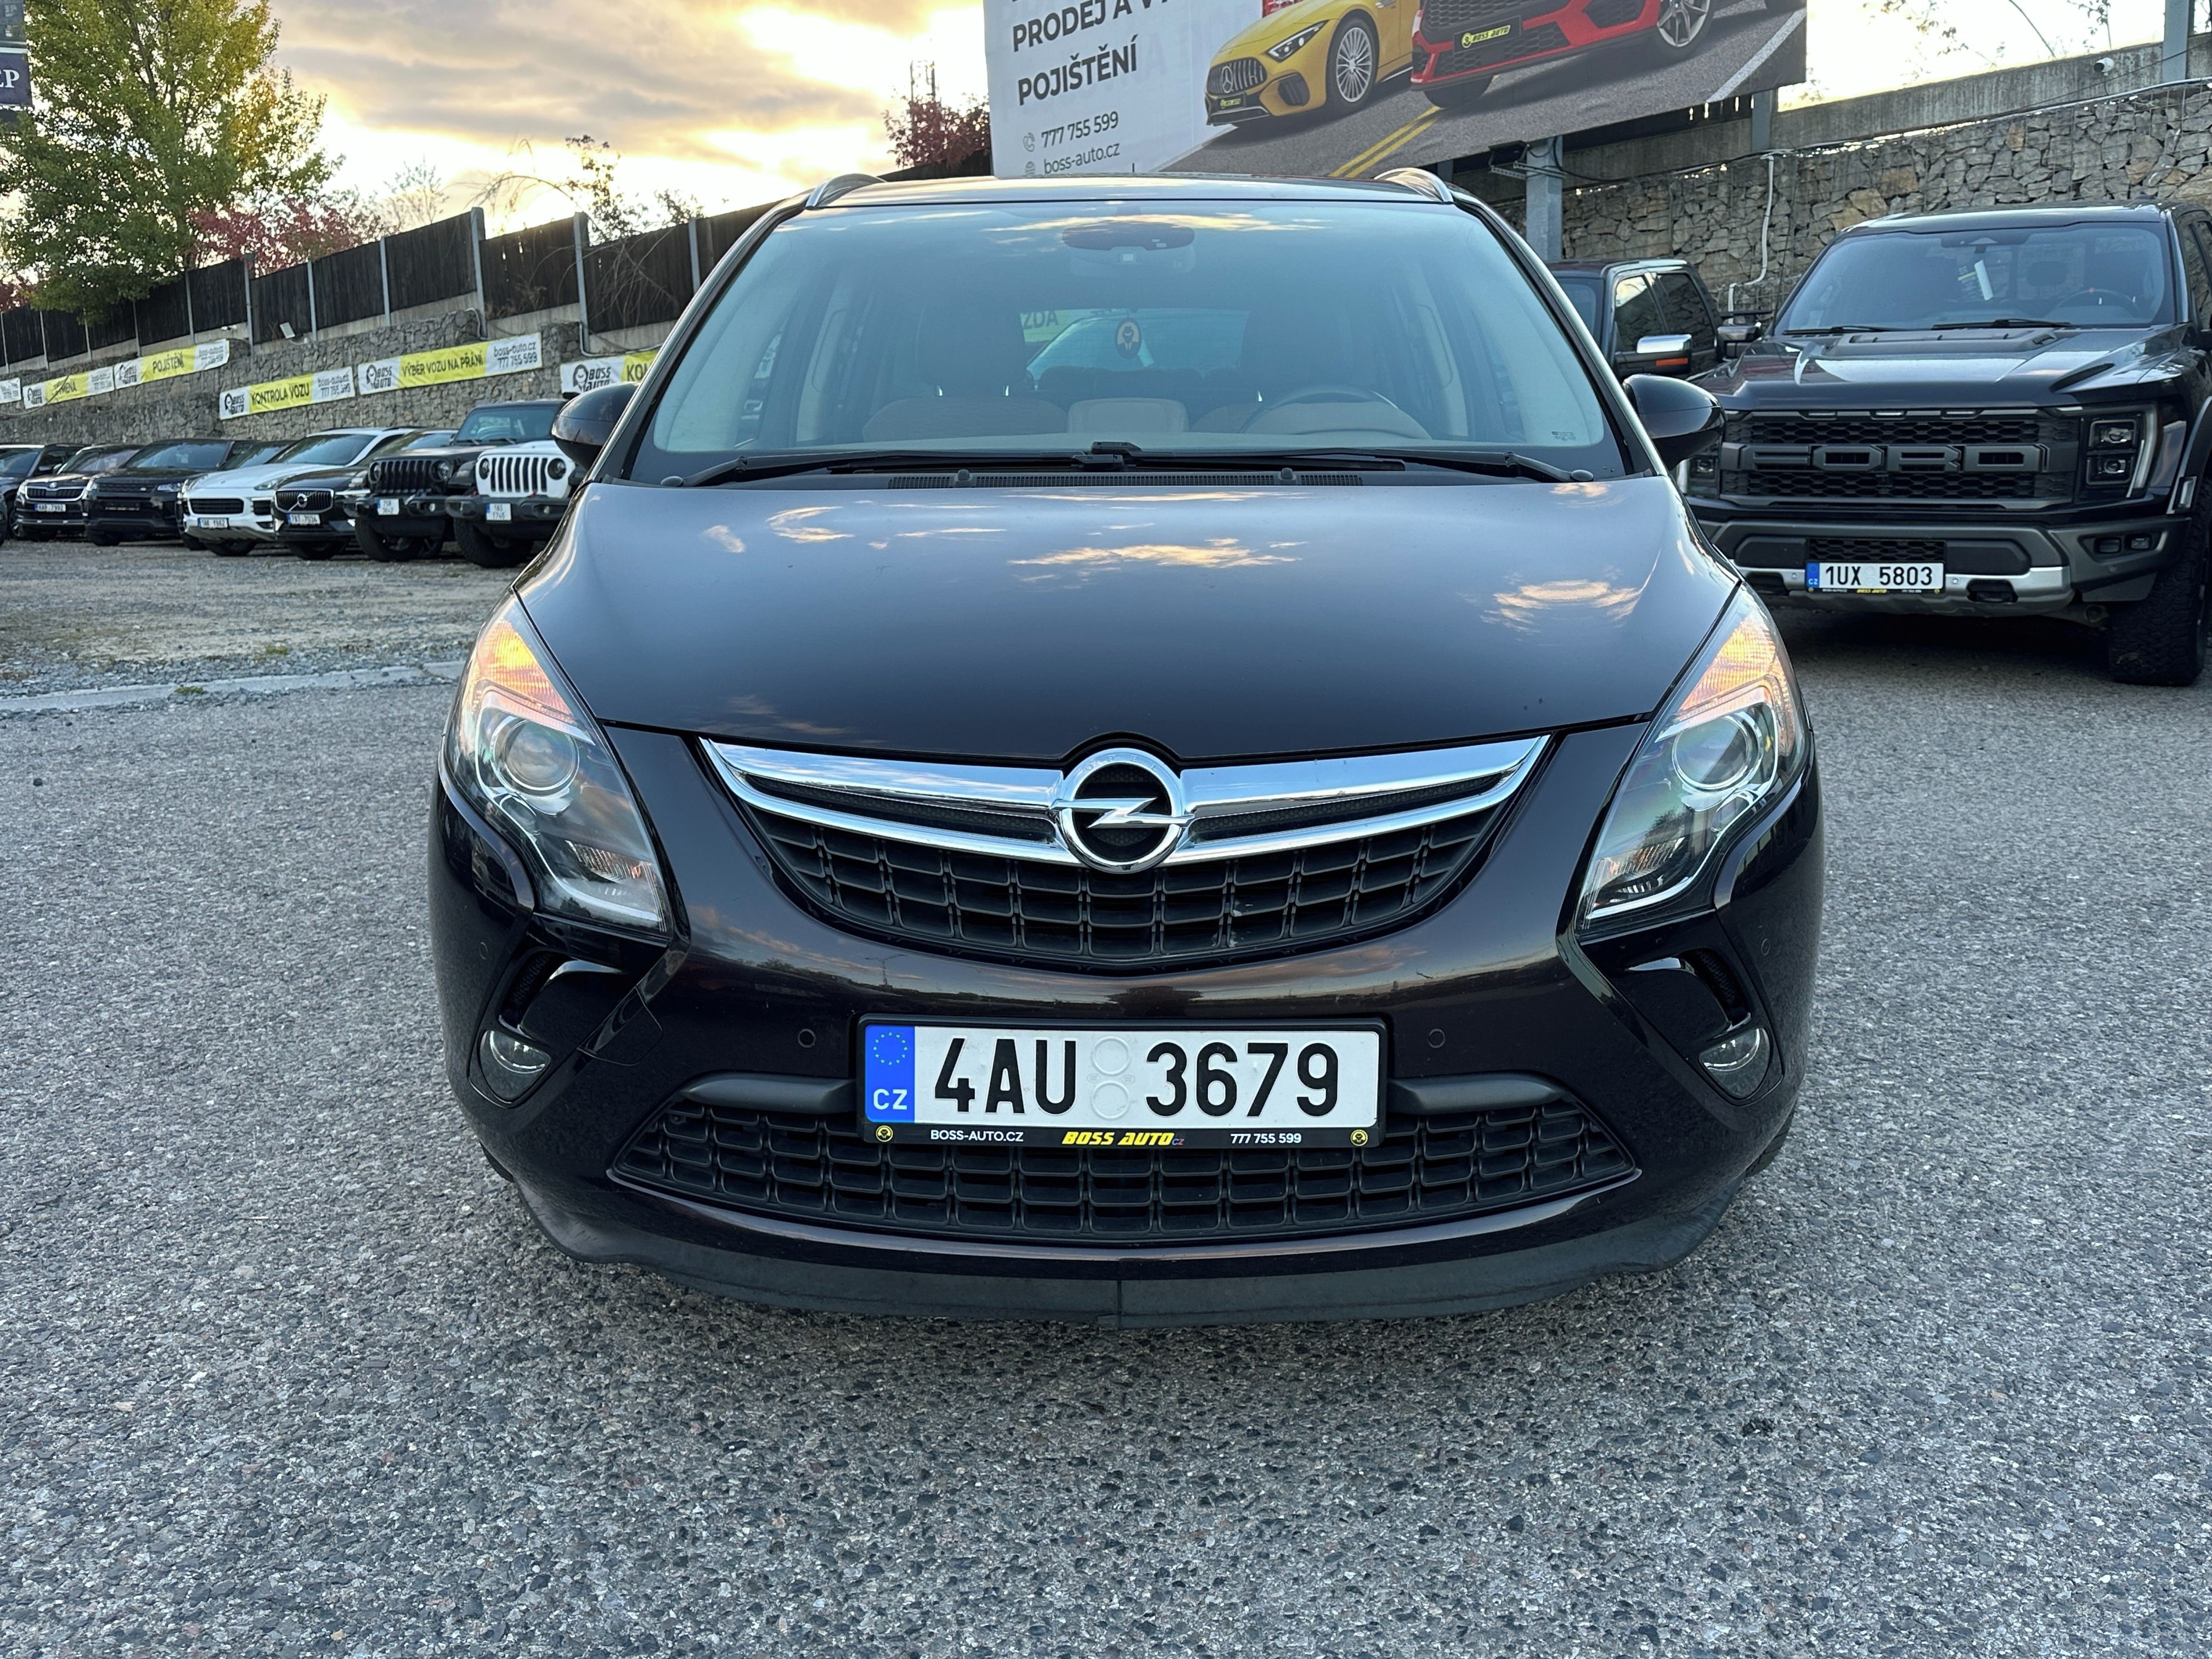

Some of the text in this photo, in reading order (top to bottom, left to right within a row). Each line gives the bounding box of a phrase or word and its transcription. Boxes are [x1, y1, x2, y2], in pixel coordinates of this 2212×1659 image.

[1013, 0, 1105, 52] PRODEJ
[1018, 34, 1138, 106] POJIŠTĚNÍ
[1041, 111, 1119, 148] 777 755 599
[1043, 143, 1120, 174] boss-auto.cz
[426, 359, 446, 373] VOZU
[447, 358, 460, 371] NA
[589, 366, 611, 380] BOSS
[250, 383, 310, 405] KONTROLA VOZU
[1740, 444, 2043, 473] FORD
[1826, 566, 1861, 585] 1UX
[1880, 566, 1933, 586] 5803
[873, 1037, 1339, 1117] CZ 4AU 3679
[930, 1129, 1024, 1142] BOSS-AUTO.CZ
[1062, 1131, 1115, 1145] BOSS
[1230, 1133, 1251, 1144] 777
[1254, 1133, 1276, 1144] 755
[1278, 1133, 1302, 1144] 599
